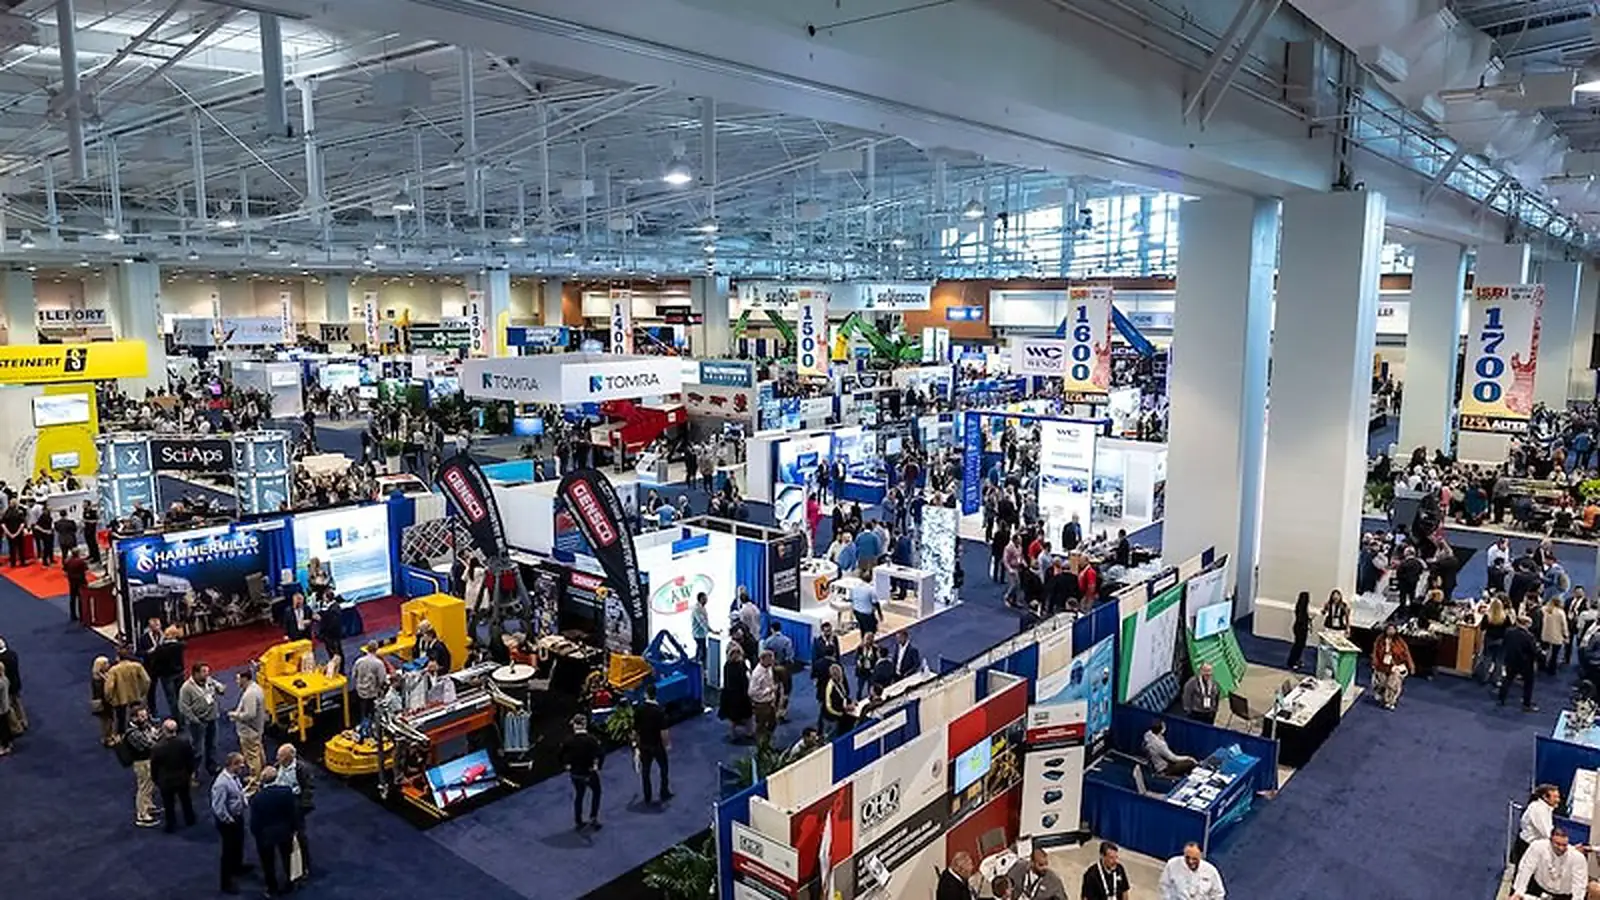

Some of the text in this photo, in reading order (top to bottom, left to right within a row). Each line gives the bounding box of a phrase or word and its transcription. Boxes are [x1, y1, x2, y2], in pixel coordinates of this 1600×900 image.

[470, 303, 481, 350] 1300
[614, 304, 624, 354] 1400
[803, 305, 815, 367] 1500
[1072, 305, 1091, 381] 1600
[1474, 307, 1504, 403] 1700
[494, 373, 540, 391] TOMRA
[605, 374, 660, 390] TOMRA
[1492, 419, 1528, 432] ALTER
[128, 451, 140, 465] X
[162, 446, 223, 465] SciAps
[265, 450, 277, 463] X
[573, 484, 612, 545] GENSCO
[154, 536, 259, 563] HAMMERMILLS
[155, 549, 259, 570] INTERNATIONAL
